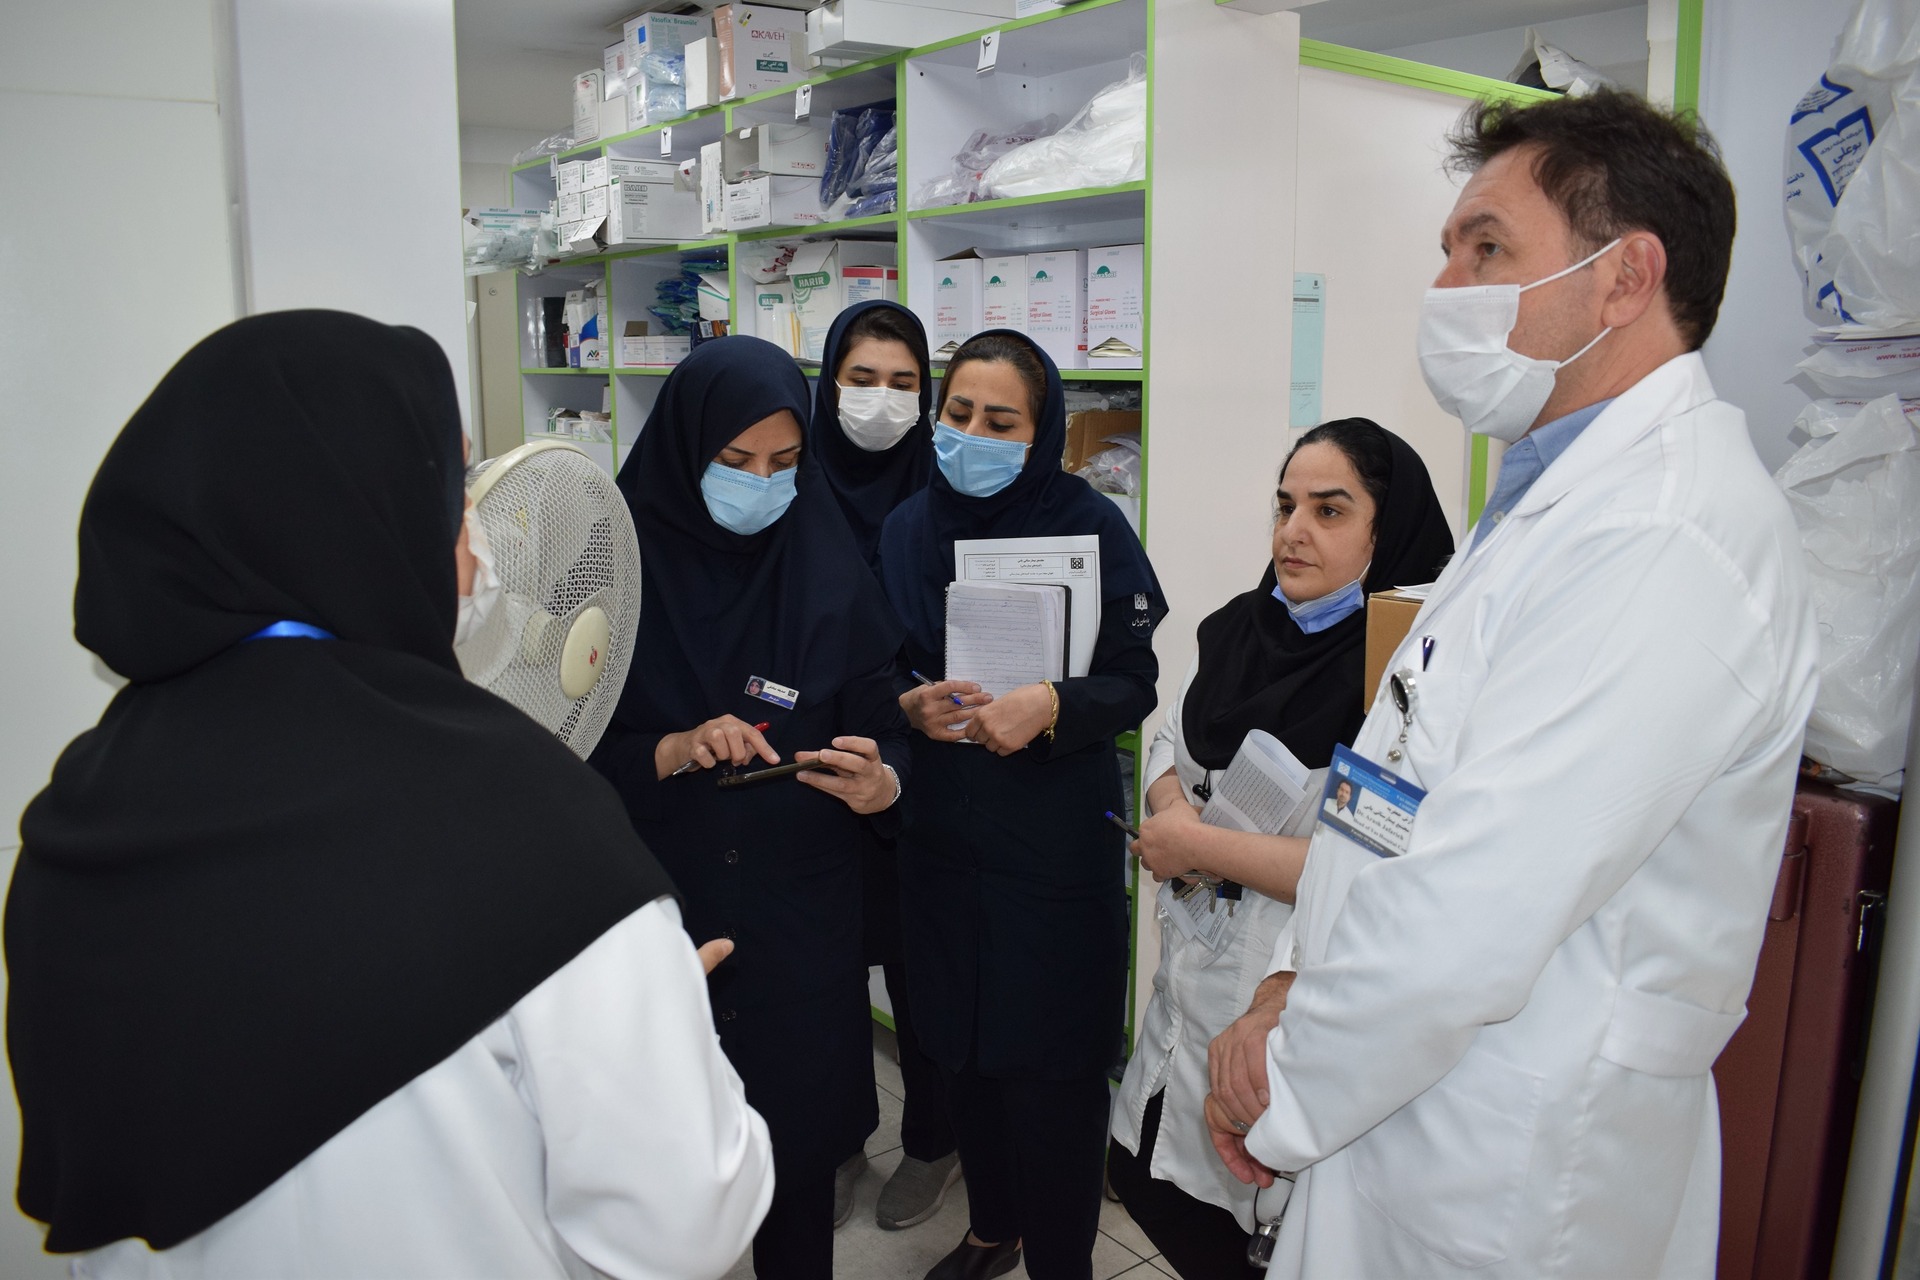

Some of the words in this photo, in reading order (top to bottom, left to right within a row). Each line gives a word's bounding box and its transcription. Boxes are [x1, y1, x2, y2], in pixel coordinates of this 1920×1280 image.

[650, 15, 671, 24] Vasofix
[758, 30, 786, 41] KAVEH
[1832, 140, 1863, 164] بوعلی
[798, 276, 825, 289] HARIR
